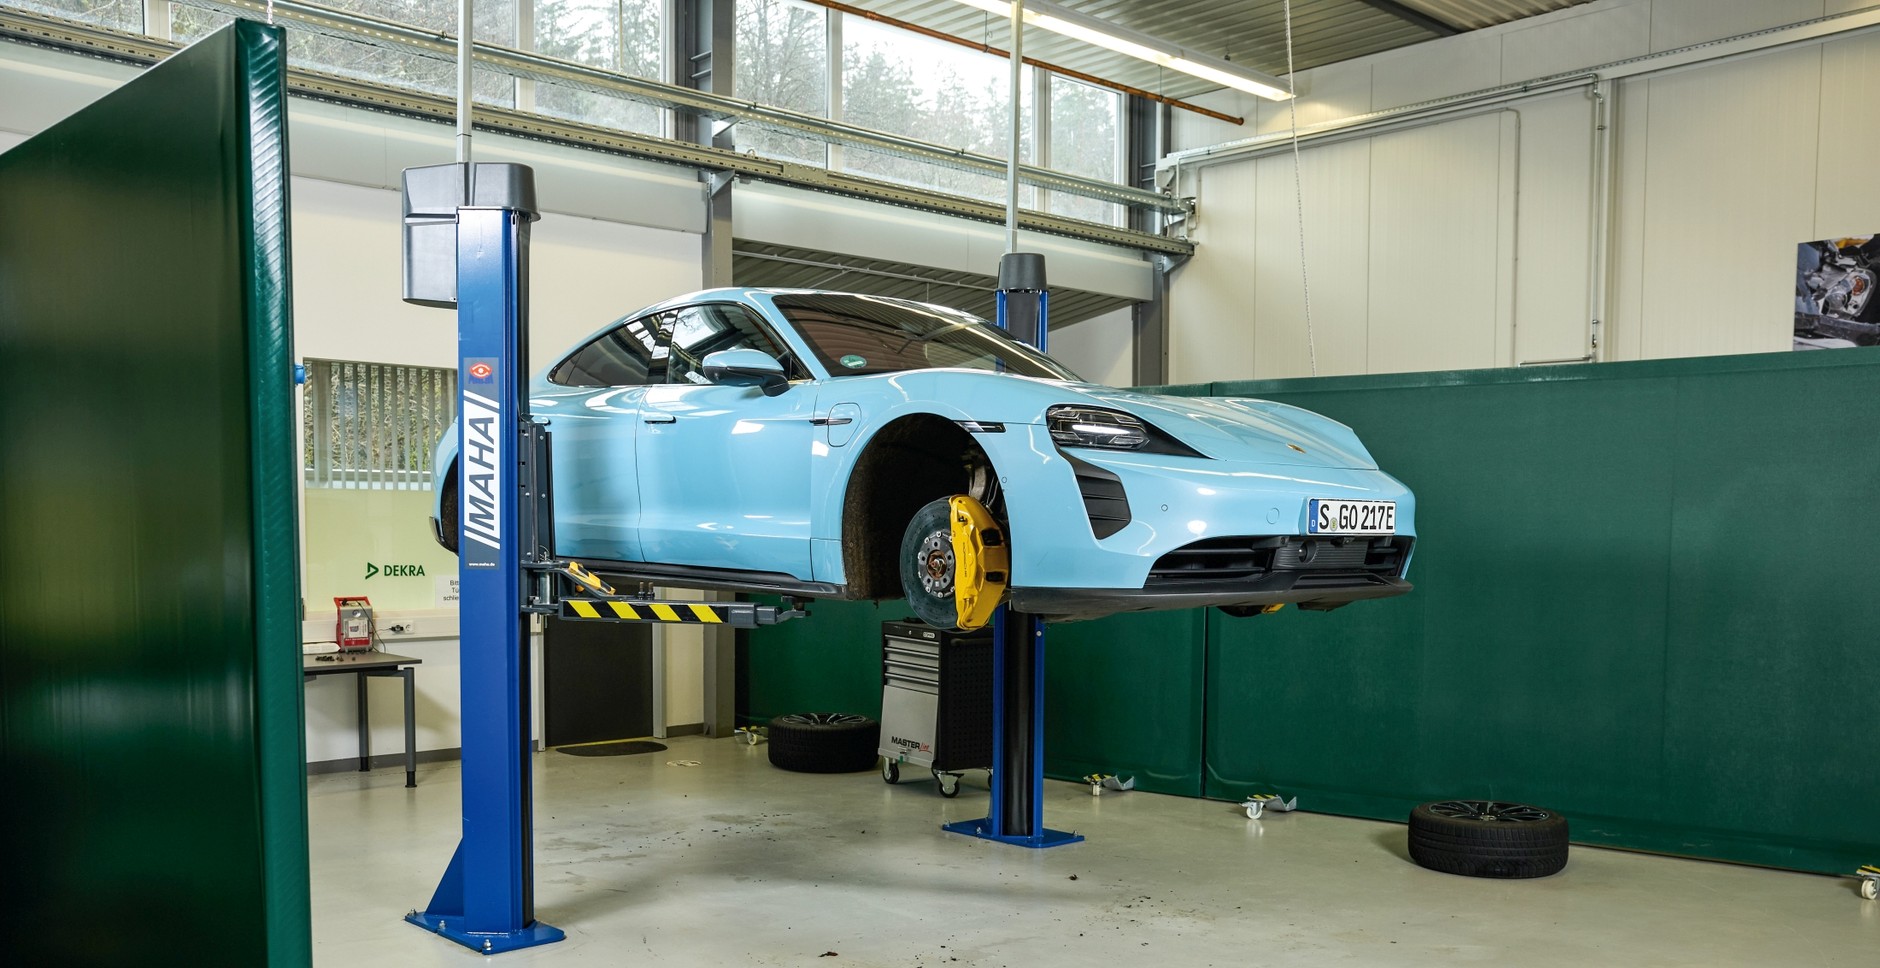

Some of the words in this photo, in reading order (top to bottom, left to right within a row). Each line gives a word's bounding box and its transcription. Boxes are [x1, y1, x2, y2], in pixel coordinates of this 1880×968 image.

[468, 416, 495, 531] MAHA
[1311, 519, 1316, 527] D
[1319, 503, 1330, 529] S
[1339, 504, 1358, 530] GO
[1361, 505, 1394, 530] 217E
[384, 565, 425, 576] DEKRA
